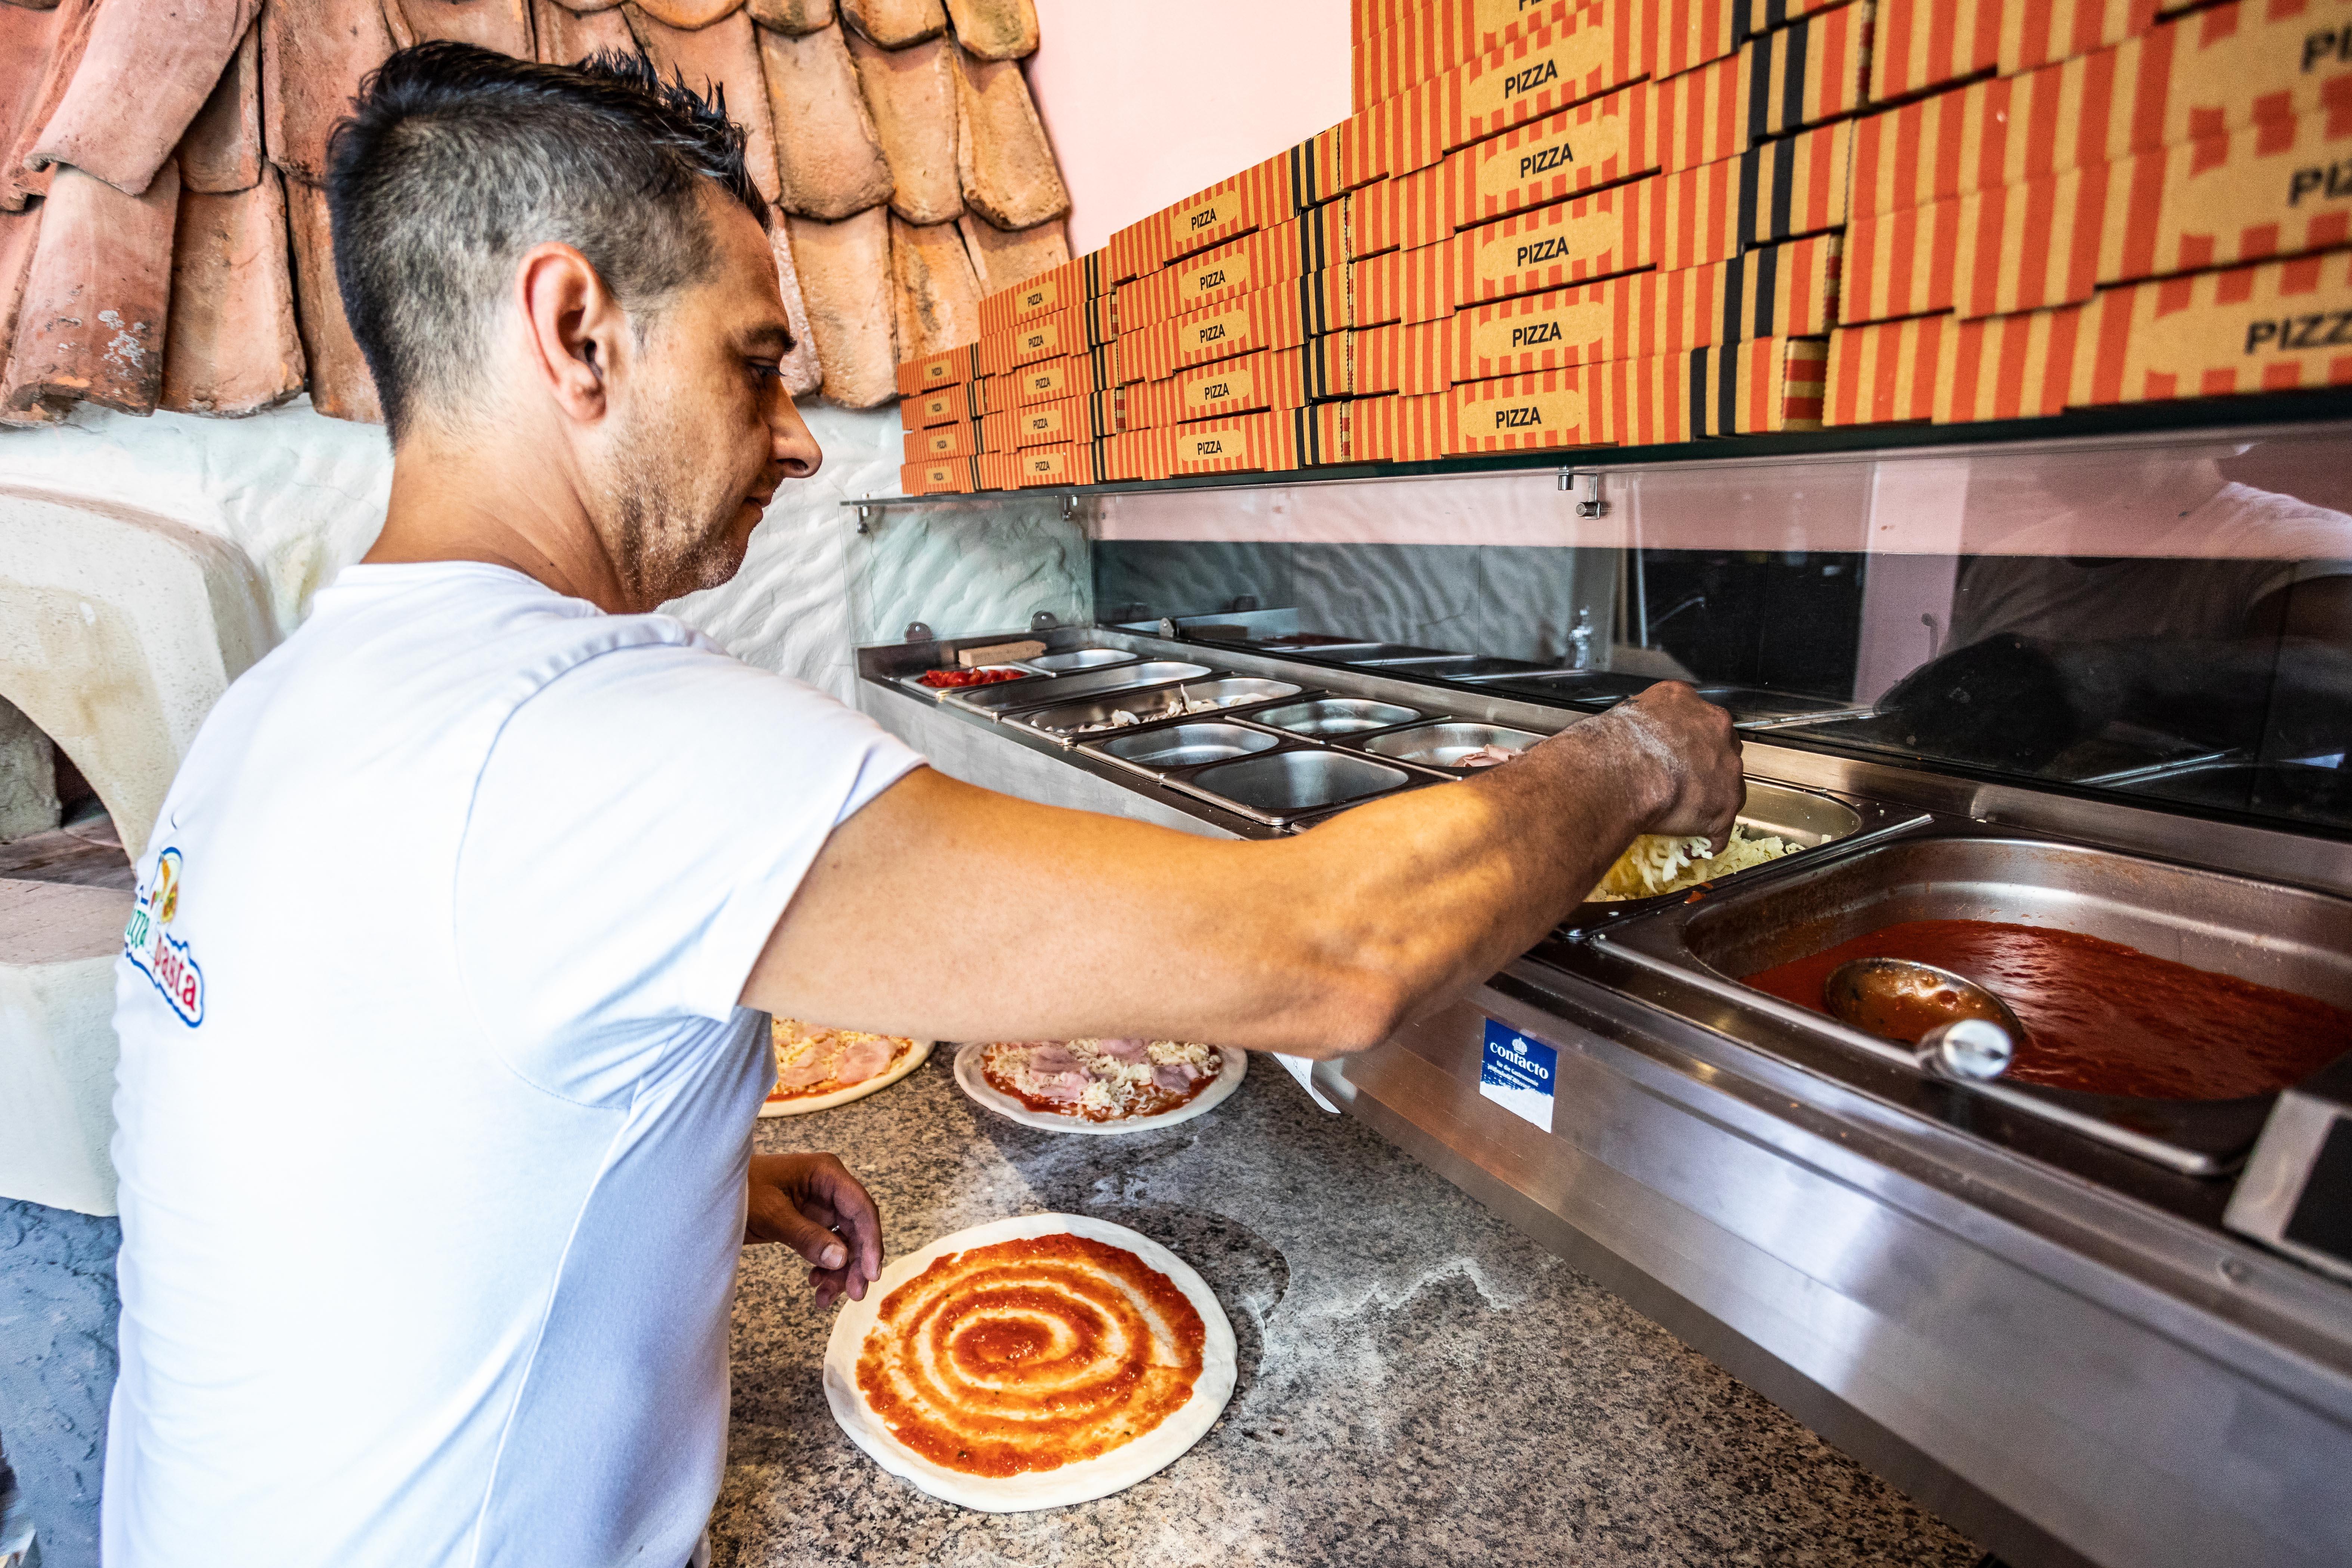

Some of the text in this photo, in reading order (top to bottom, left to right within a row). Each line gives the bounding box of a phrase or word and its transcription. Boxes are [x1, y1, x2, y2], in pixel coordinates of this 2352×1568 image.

[1505, 59, 1558, 99] PIZZA
[1520, 143, 1573, 178] PIZZA
[1192, 208, 1217, 231] PIZZA
[1517, 236, 1569, 267] PIZZA
[1200, 270, 1225, 291] PIZZA
[1027, 292, 1043, 306] PIZZA
[1028, 335, 1044, 348] PIZZA
[1200, 324, 1225, 344] PIZZA
[1513, 321, 1562, 347] PIZZA
[1035, 376, 1051, 390] PIZZA
[1205, 382, 1230, 400] PIZZA
[1033, 418, 1048, 430] PIZZA
[1496, 407, 1542, 429] PIZZA
[1197, 440, 1223, 456] PIZZA
[1035, 461, 1050, 472] PIZZA
[1490, 1042, 1549, 1079] contacto
[1511, 1068, 1539, 1087] Gastronomie
